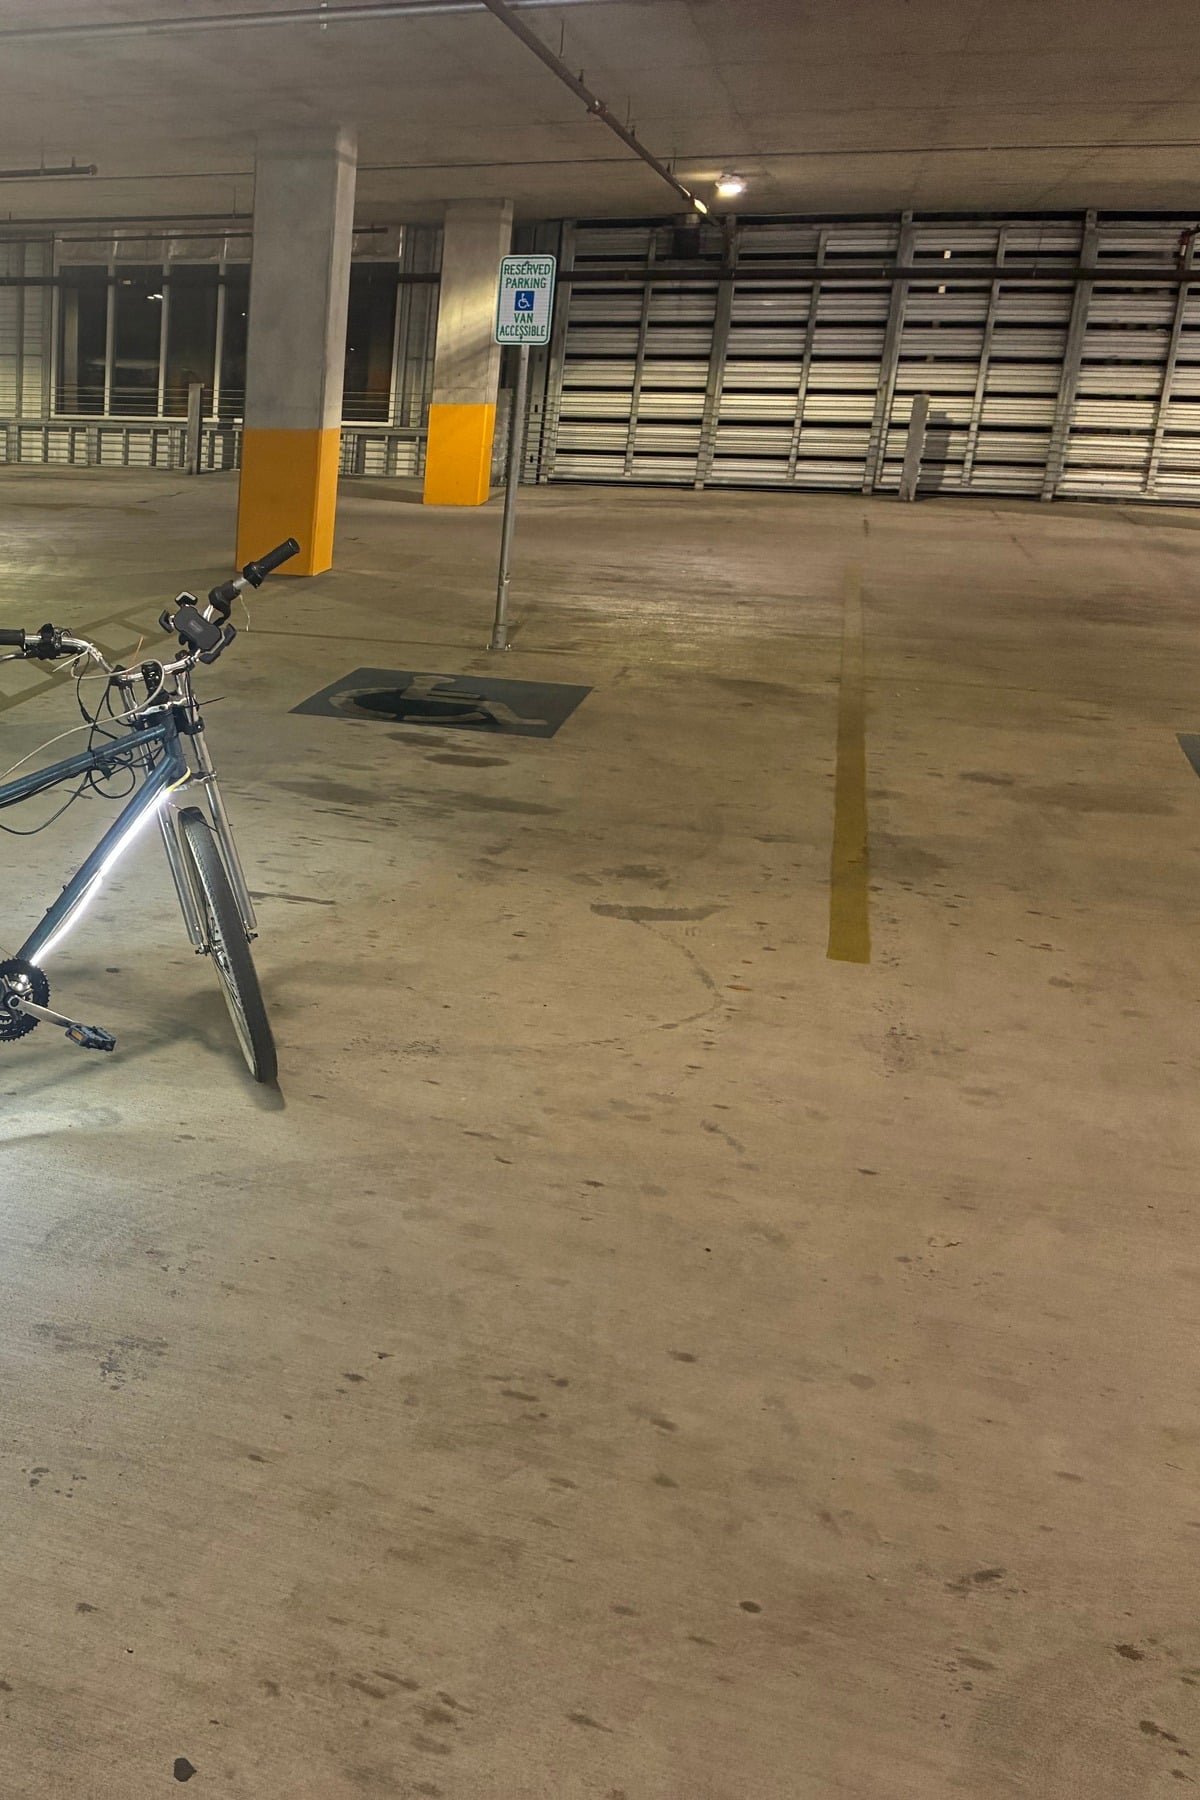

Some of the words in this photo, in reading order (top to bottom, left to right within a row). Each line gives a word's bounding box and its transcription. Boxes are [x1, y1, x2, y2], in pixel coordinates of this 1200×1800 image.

[504, 264, 551, 275] RESERVED
[505, 277, 547, 289] PARKING
[514, 313, 534, 324] VAN
[500, 325, 546, 337] ACCESSIBLE
